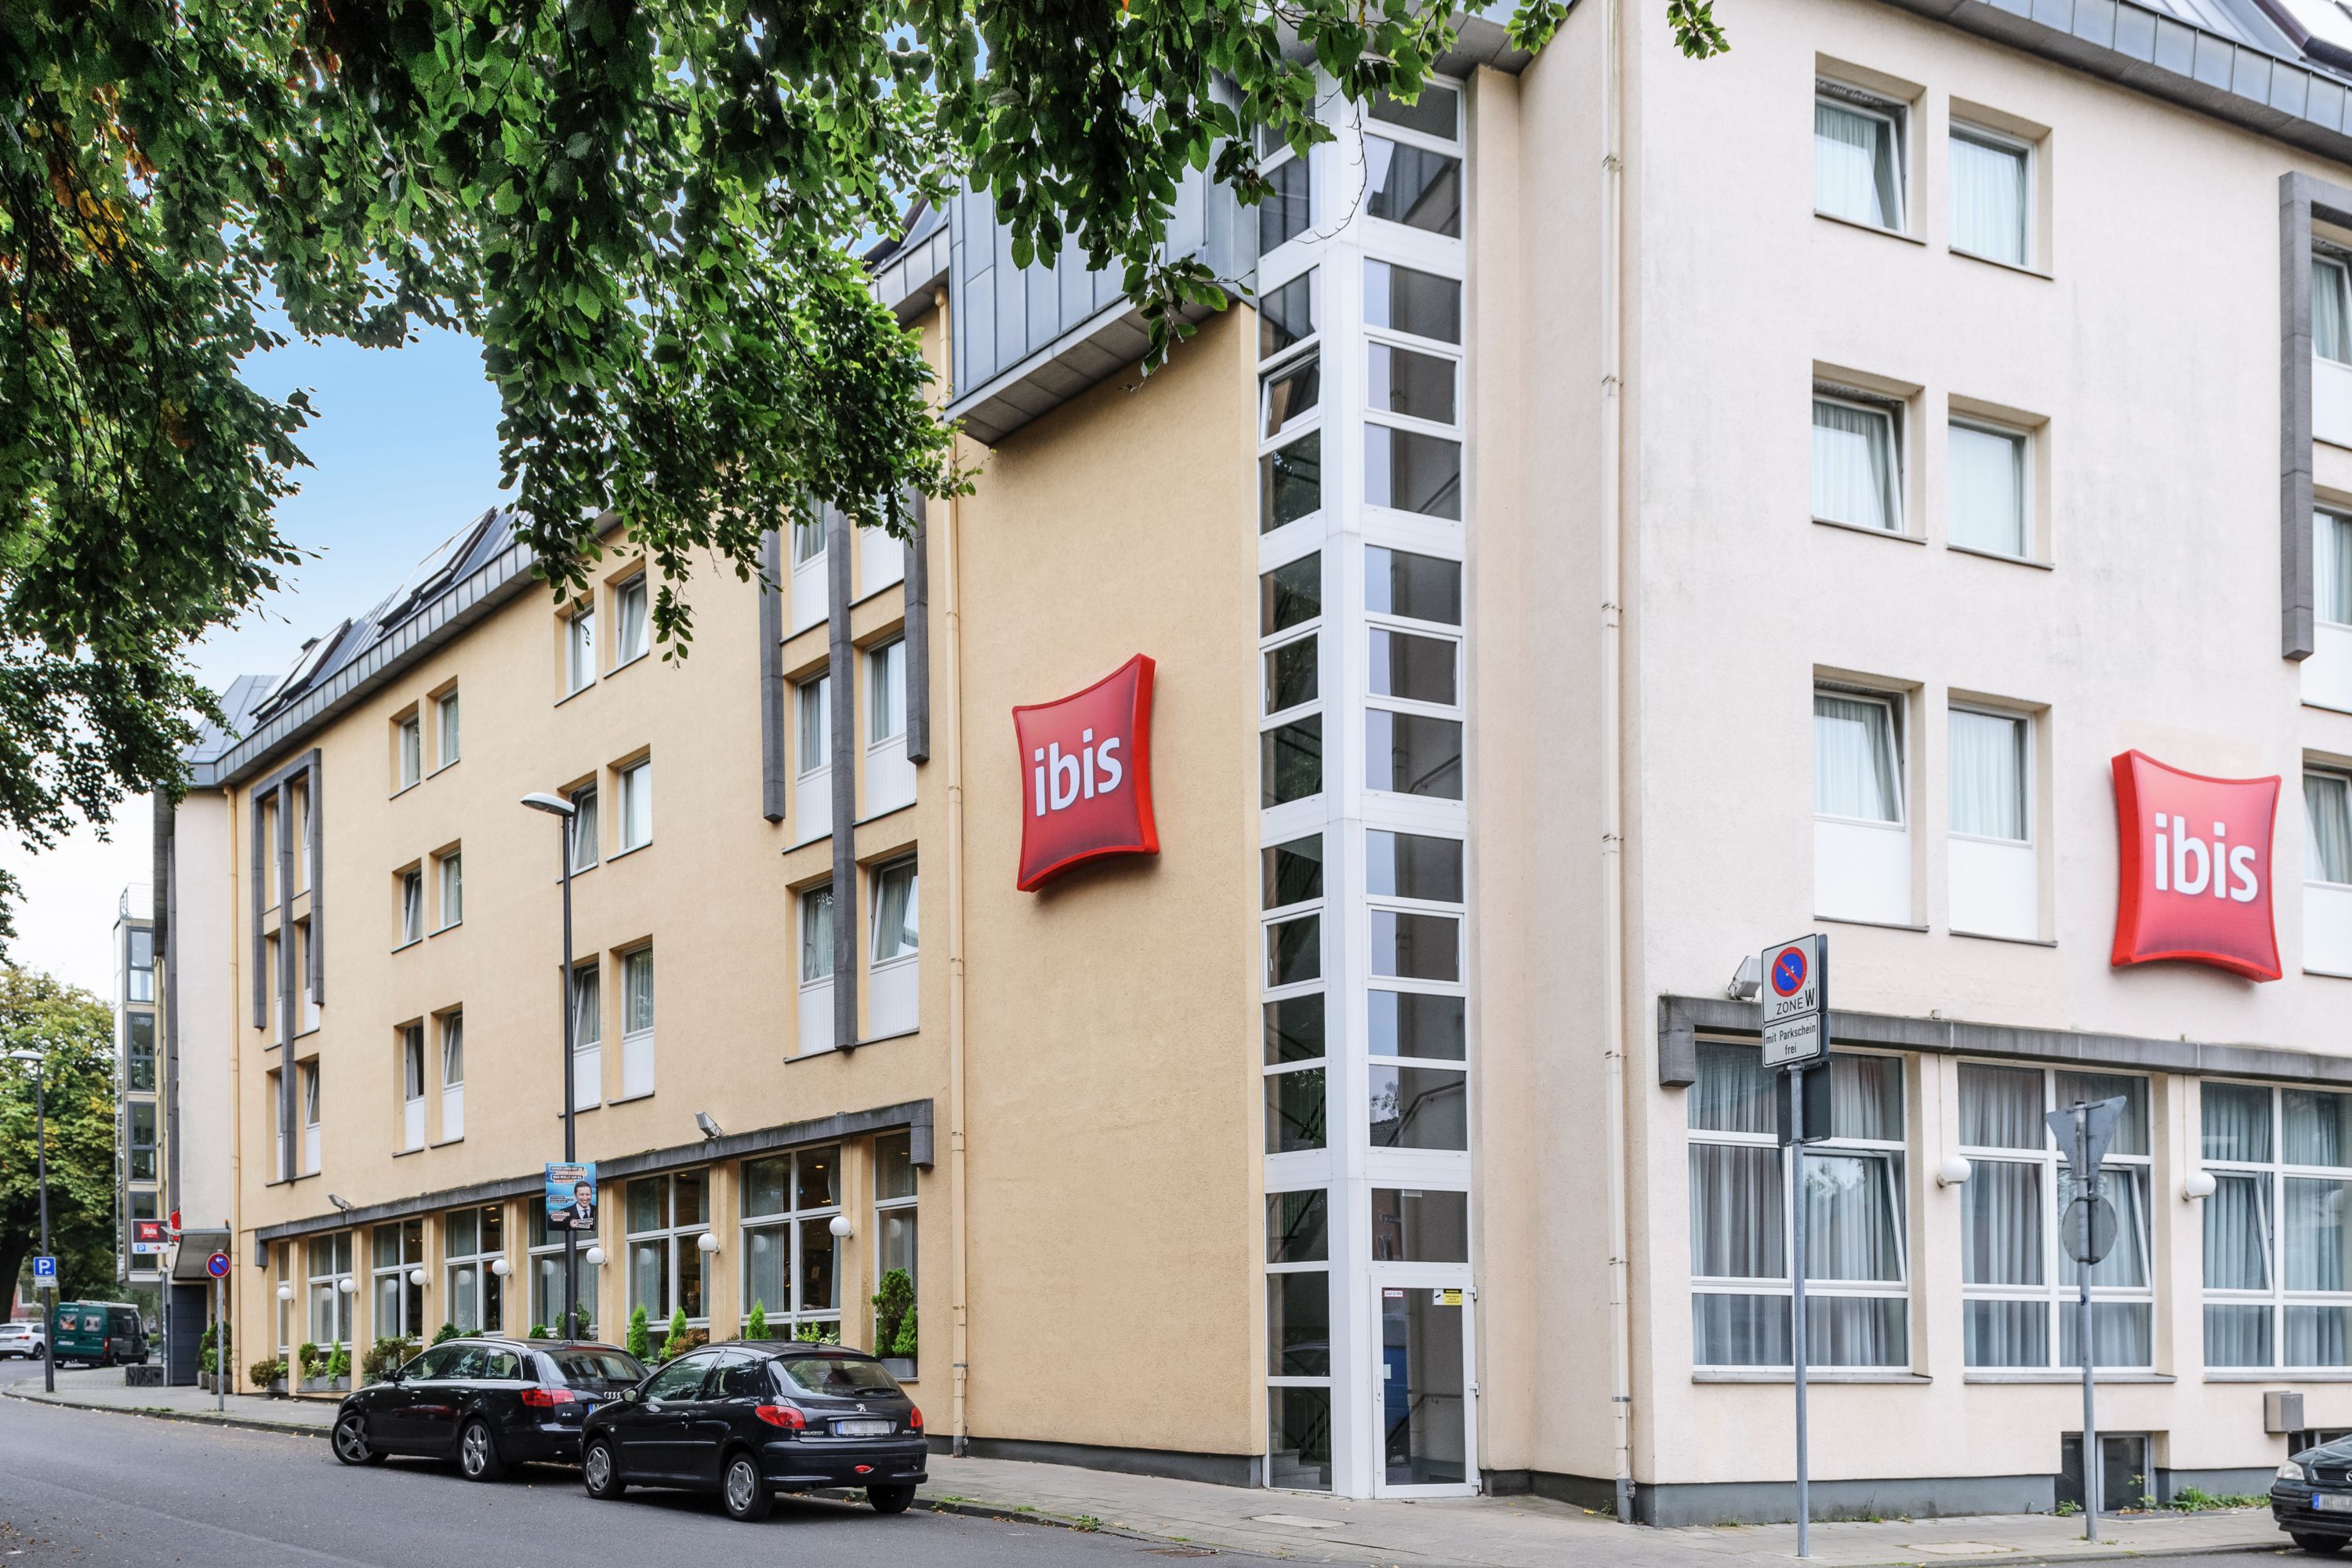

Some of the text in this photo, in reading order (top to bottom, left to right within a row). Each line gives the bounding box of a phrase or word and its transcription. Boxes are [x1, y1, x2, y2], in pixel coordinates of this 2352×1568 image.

[1035, 728, 1123, 817] ibis
[2155, 812, 2258, 902] ibis
[1777, 988, 1815, 1015] ZONE W
[1766, 1022, 1816, 1045] mit Parkschein
[1784, 1043, 1797, 1055] frei
[38, 1259, 51, 1275] P
